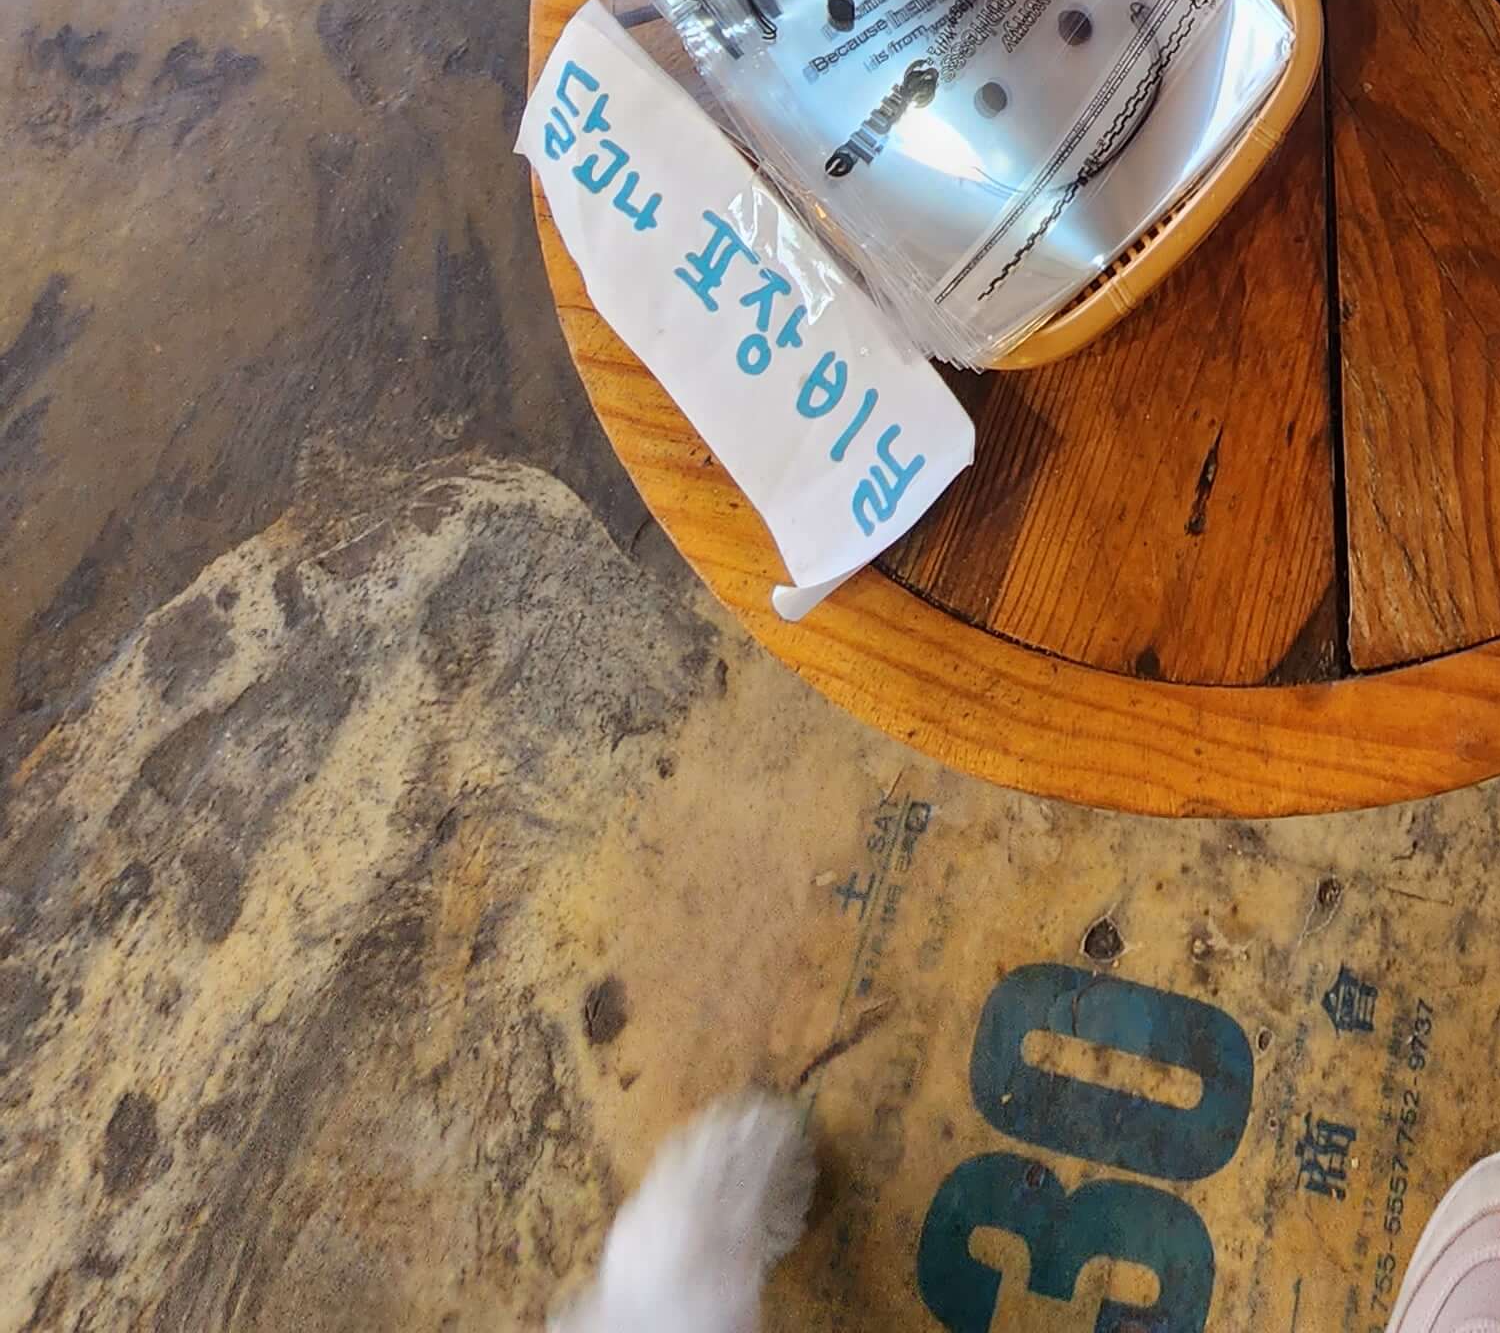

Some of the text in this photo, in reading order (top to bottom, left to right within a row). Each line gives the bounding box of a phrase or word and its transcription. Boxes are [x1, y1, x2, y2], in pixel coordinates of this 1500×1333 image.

[542, 59, 927, 538] 달고나 포장 비닐
